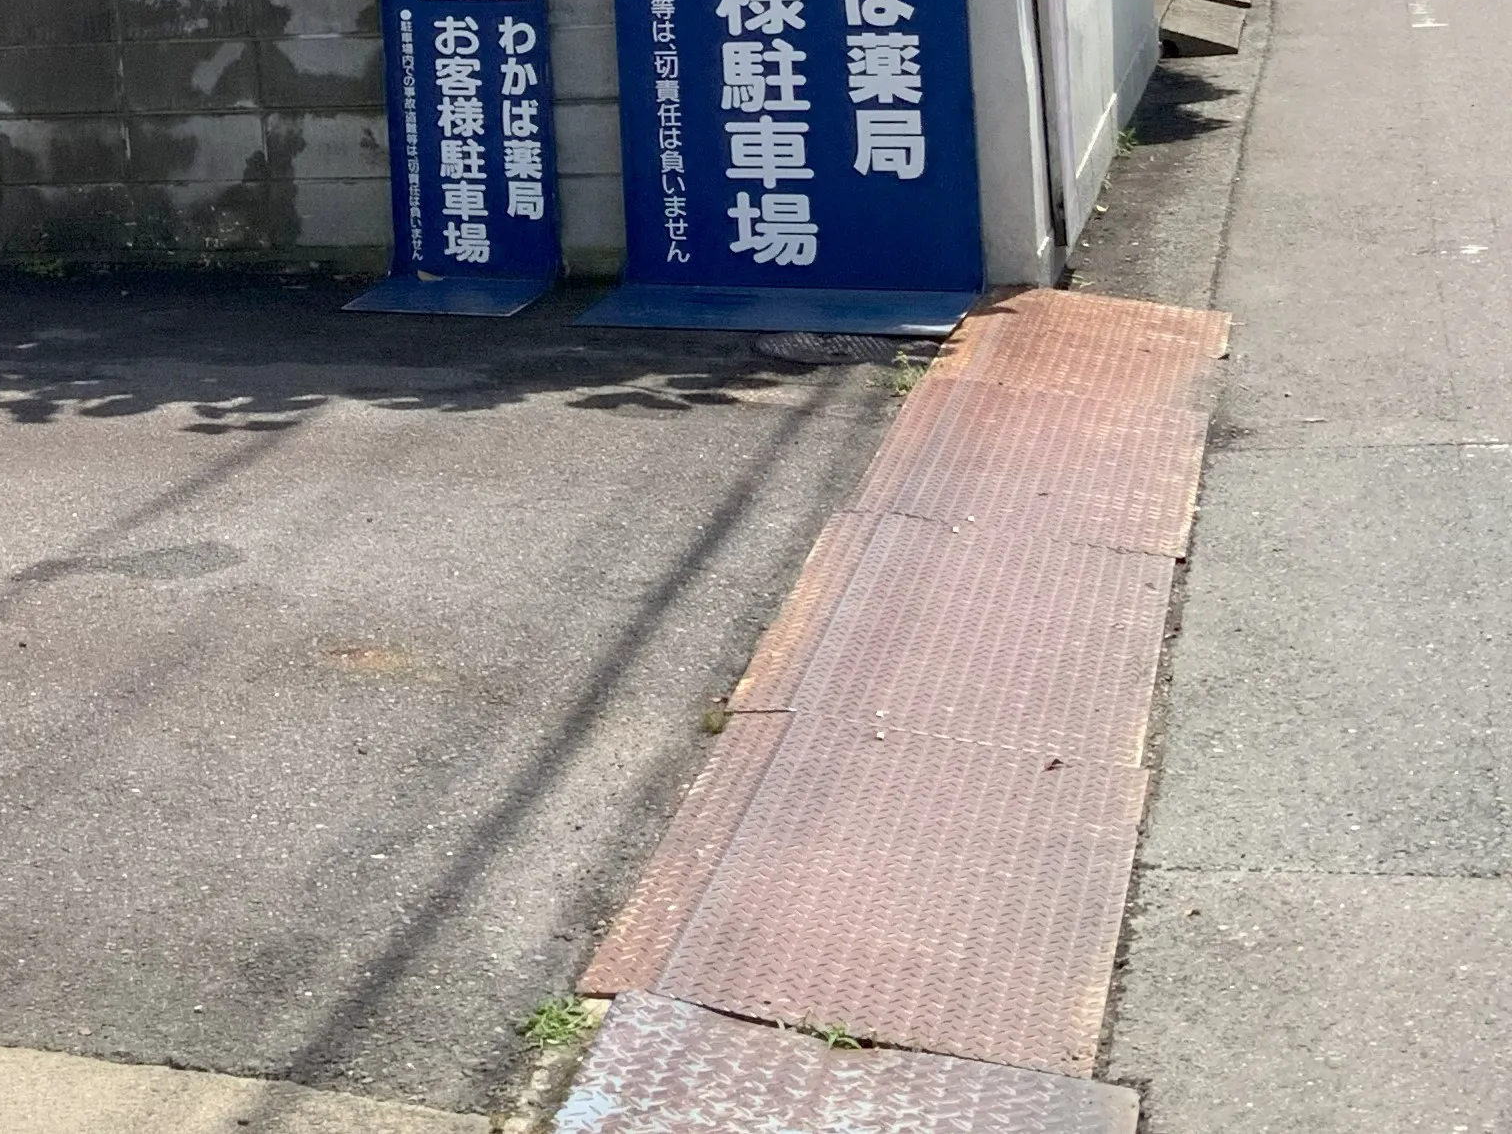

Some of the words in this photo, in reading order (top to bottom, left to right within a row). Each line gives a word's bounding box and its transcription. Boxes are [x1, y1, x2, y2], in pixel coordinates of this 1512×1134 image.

[433, 16, 491, 264] お客様駐車場
[498, 16, 545, 220] わかば薬局
